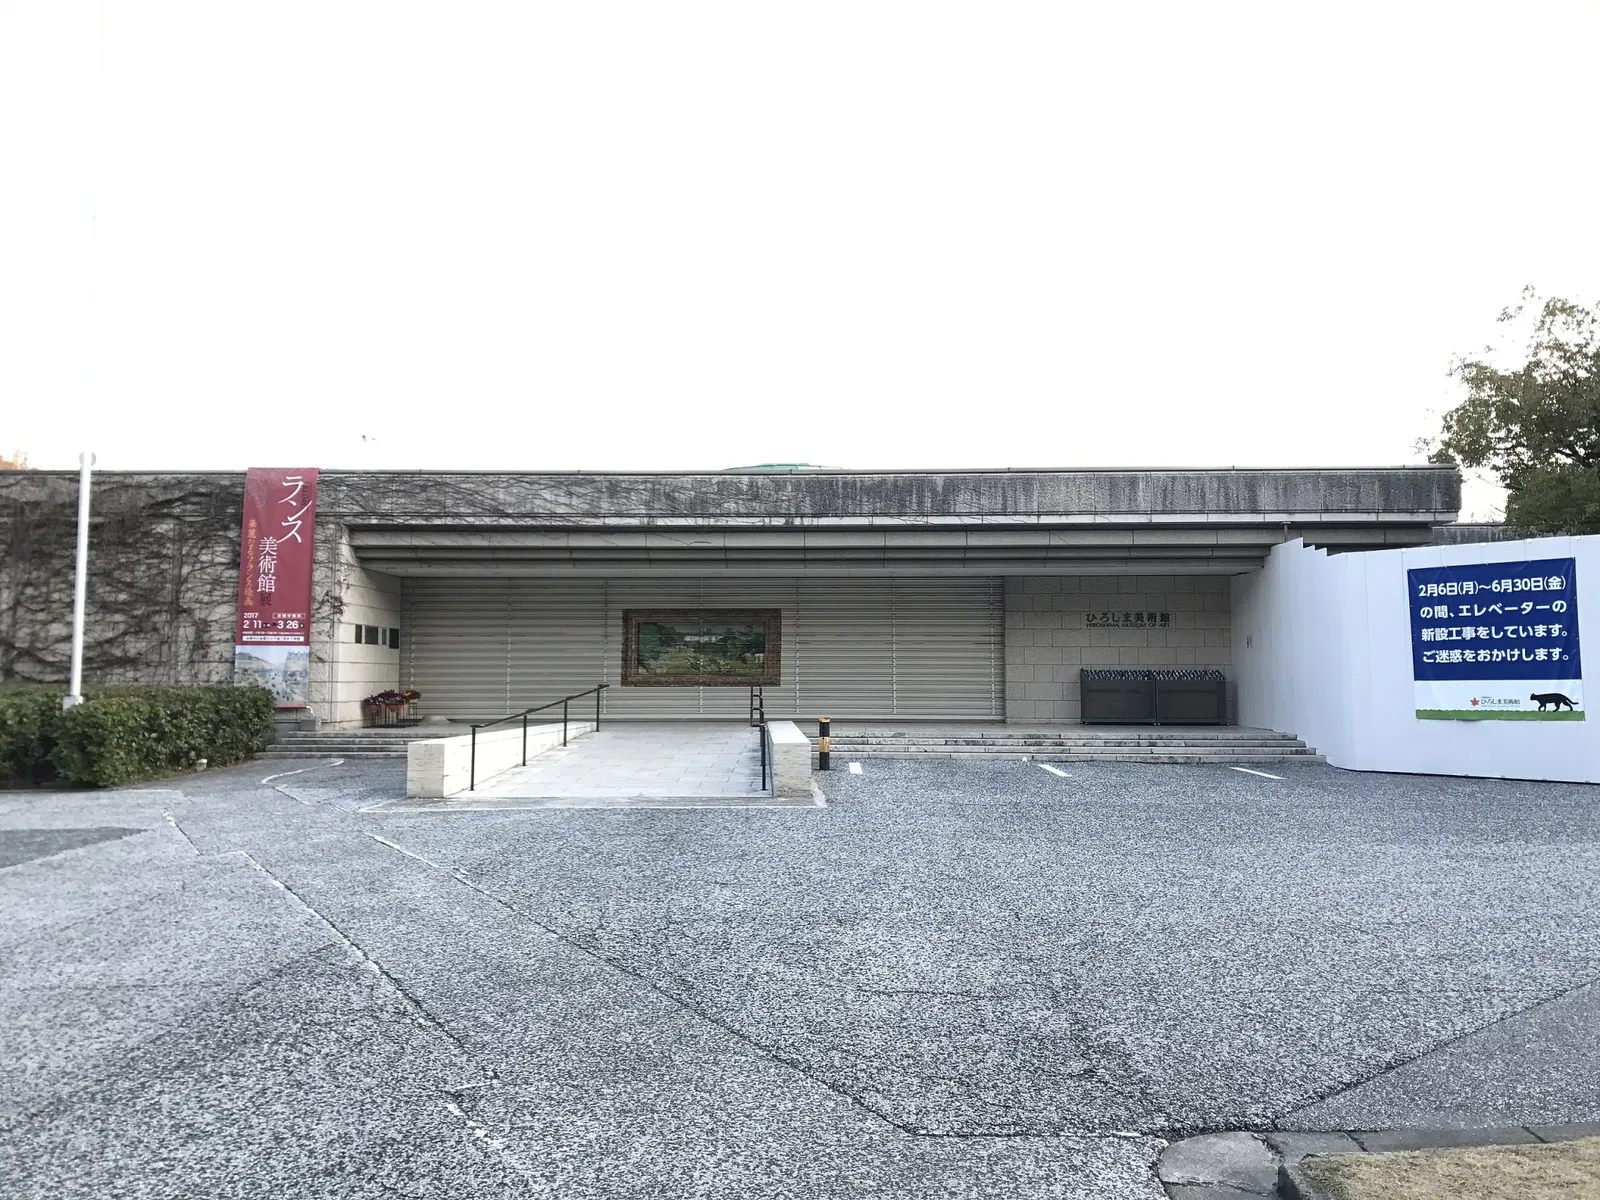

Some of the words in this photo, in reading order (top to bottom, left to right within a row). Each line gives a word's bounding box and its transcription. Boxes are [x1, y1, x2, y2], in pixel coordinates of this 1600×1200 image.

[276, 475, 313, 544] ランス
[257, 536, 278, 607] 美術館展
[1085, 612, 1171, 623] ひろしま美術館
[1420, 600, 1567, 619] の間、エレベーターの
[286, 620, 299, 629] 26
[1421, 624, 1568, 642] 新設工事をしています。
[1423, 648, 1569, 664] ご迷惑をおかけします。
